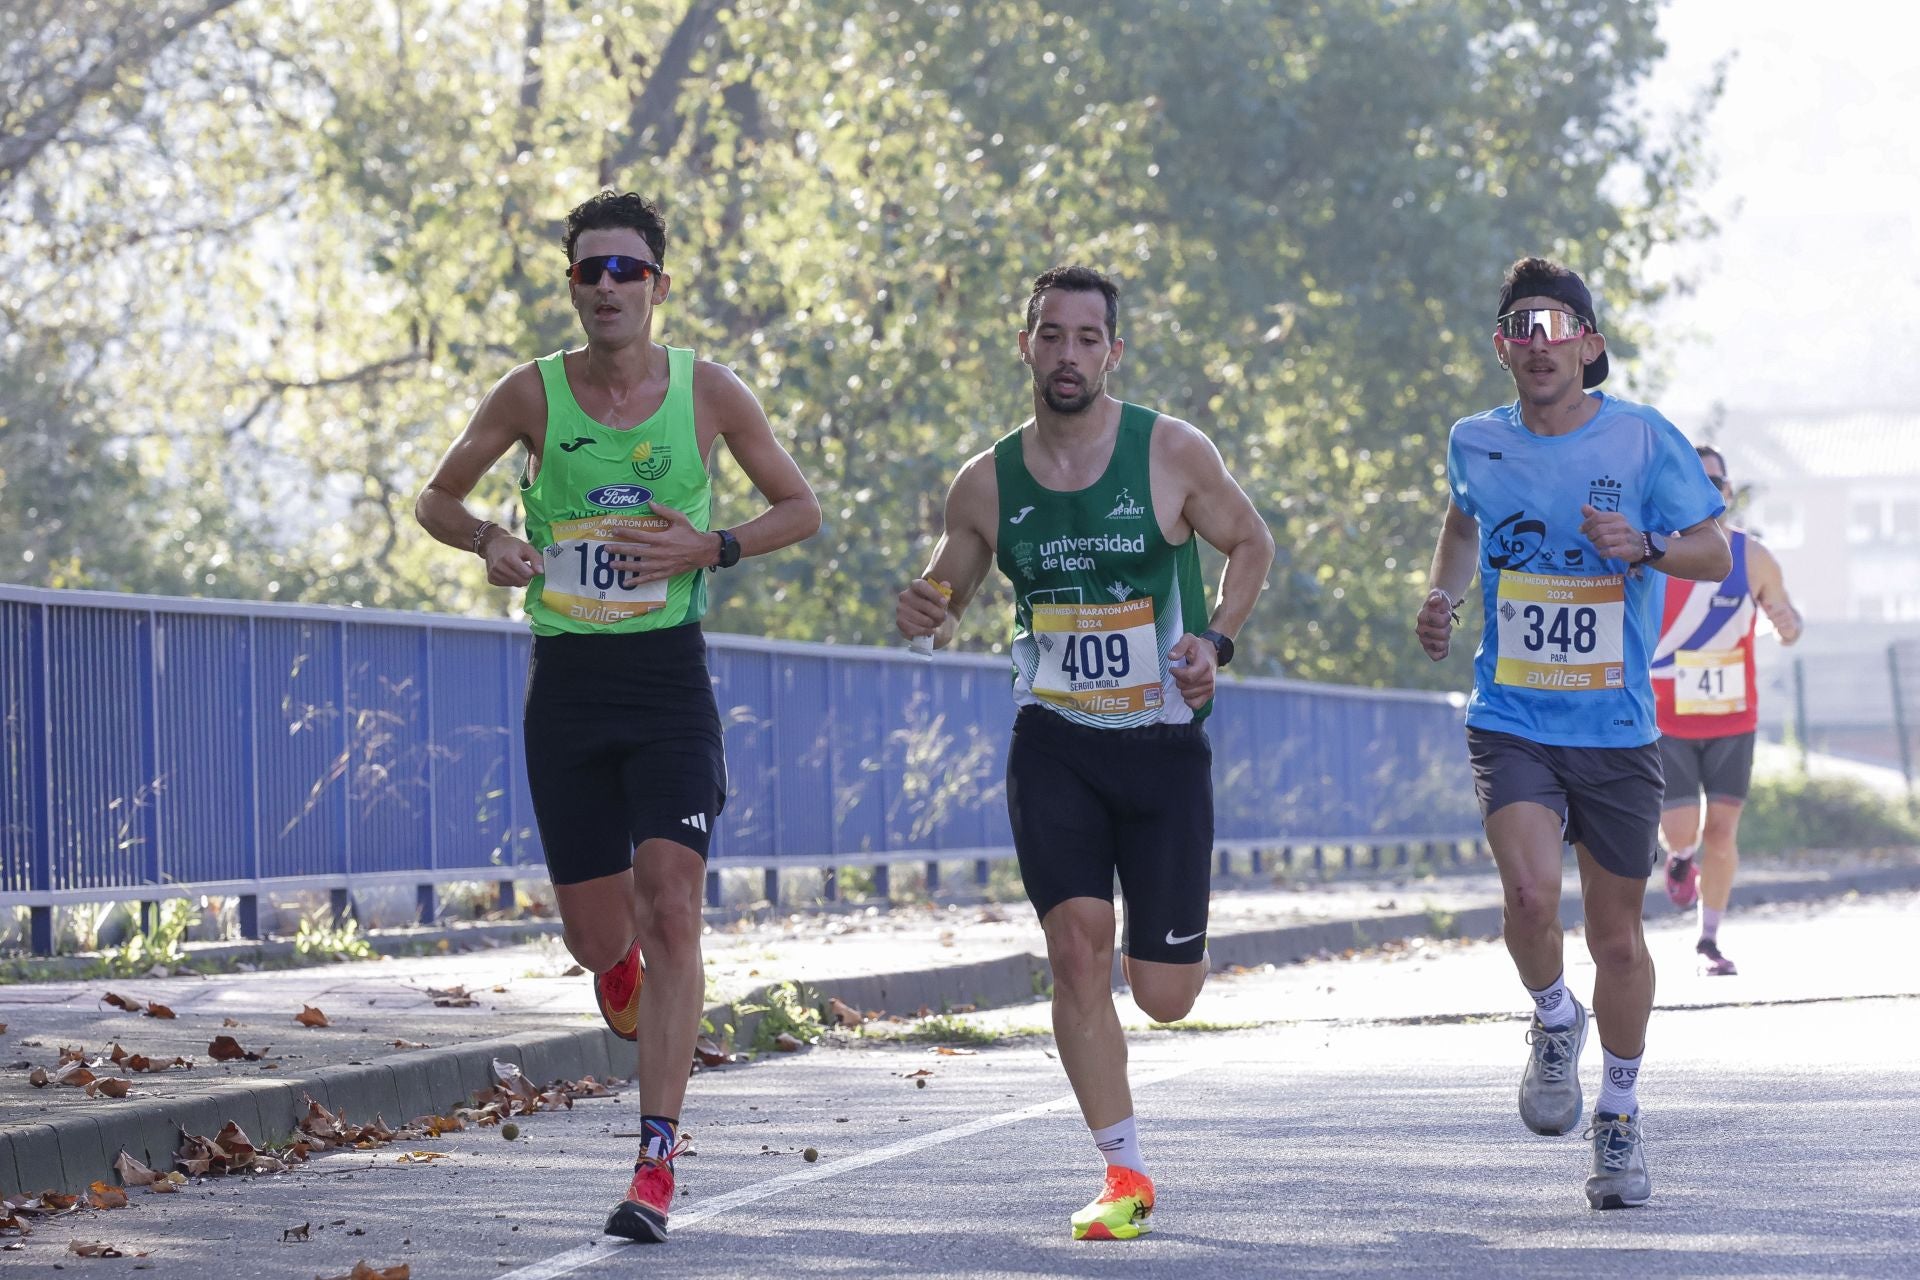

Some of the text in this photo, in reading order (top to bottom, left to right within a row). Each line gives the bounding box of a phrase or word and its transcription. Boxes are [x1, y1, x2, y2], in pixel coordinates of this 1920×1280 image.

[600, 488, 640, 505] Ford
[594, 528, 614, 538] 202
[1040, 533, 1145, 557] universidad
[1042, 553, 1096, 572] de león
[1525, 576, 1550, 586] MEDIA
[1552, 577, 1594, 588] MARATÓN
[1595, 576, 1622, 587] AVILÉS
[1547, 590, 1574, 600] 2024
[1080, 604, 1121, 616] MARATÓN
[1122, 600, 1150, 613] AVILÉS
[1076, 619, 1103, 629] 2024
[1523, 604, 1597, 654] 348
[1061, 633, 1130, 682] 409
[1070, 679, 1120, 692] SERGIO MORLA
[1526, 669, 1592, 687] avilés
[1698, 669, 1724, 695] 41
